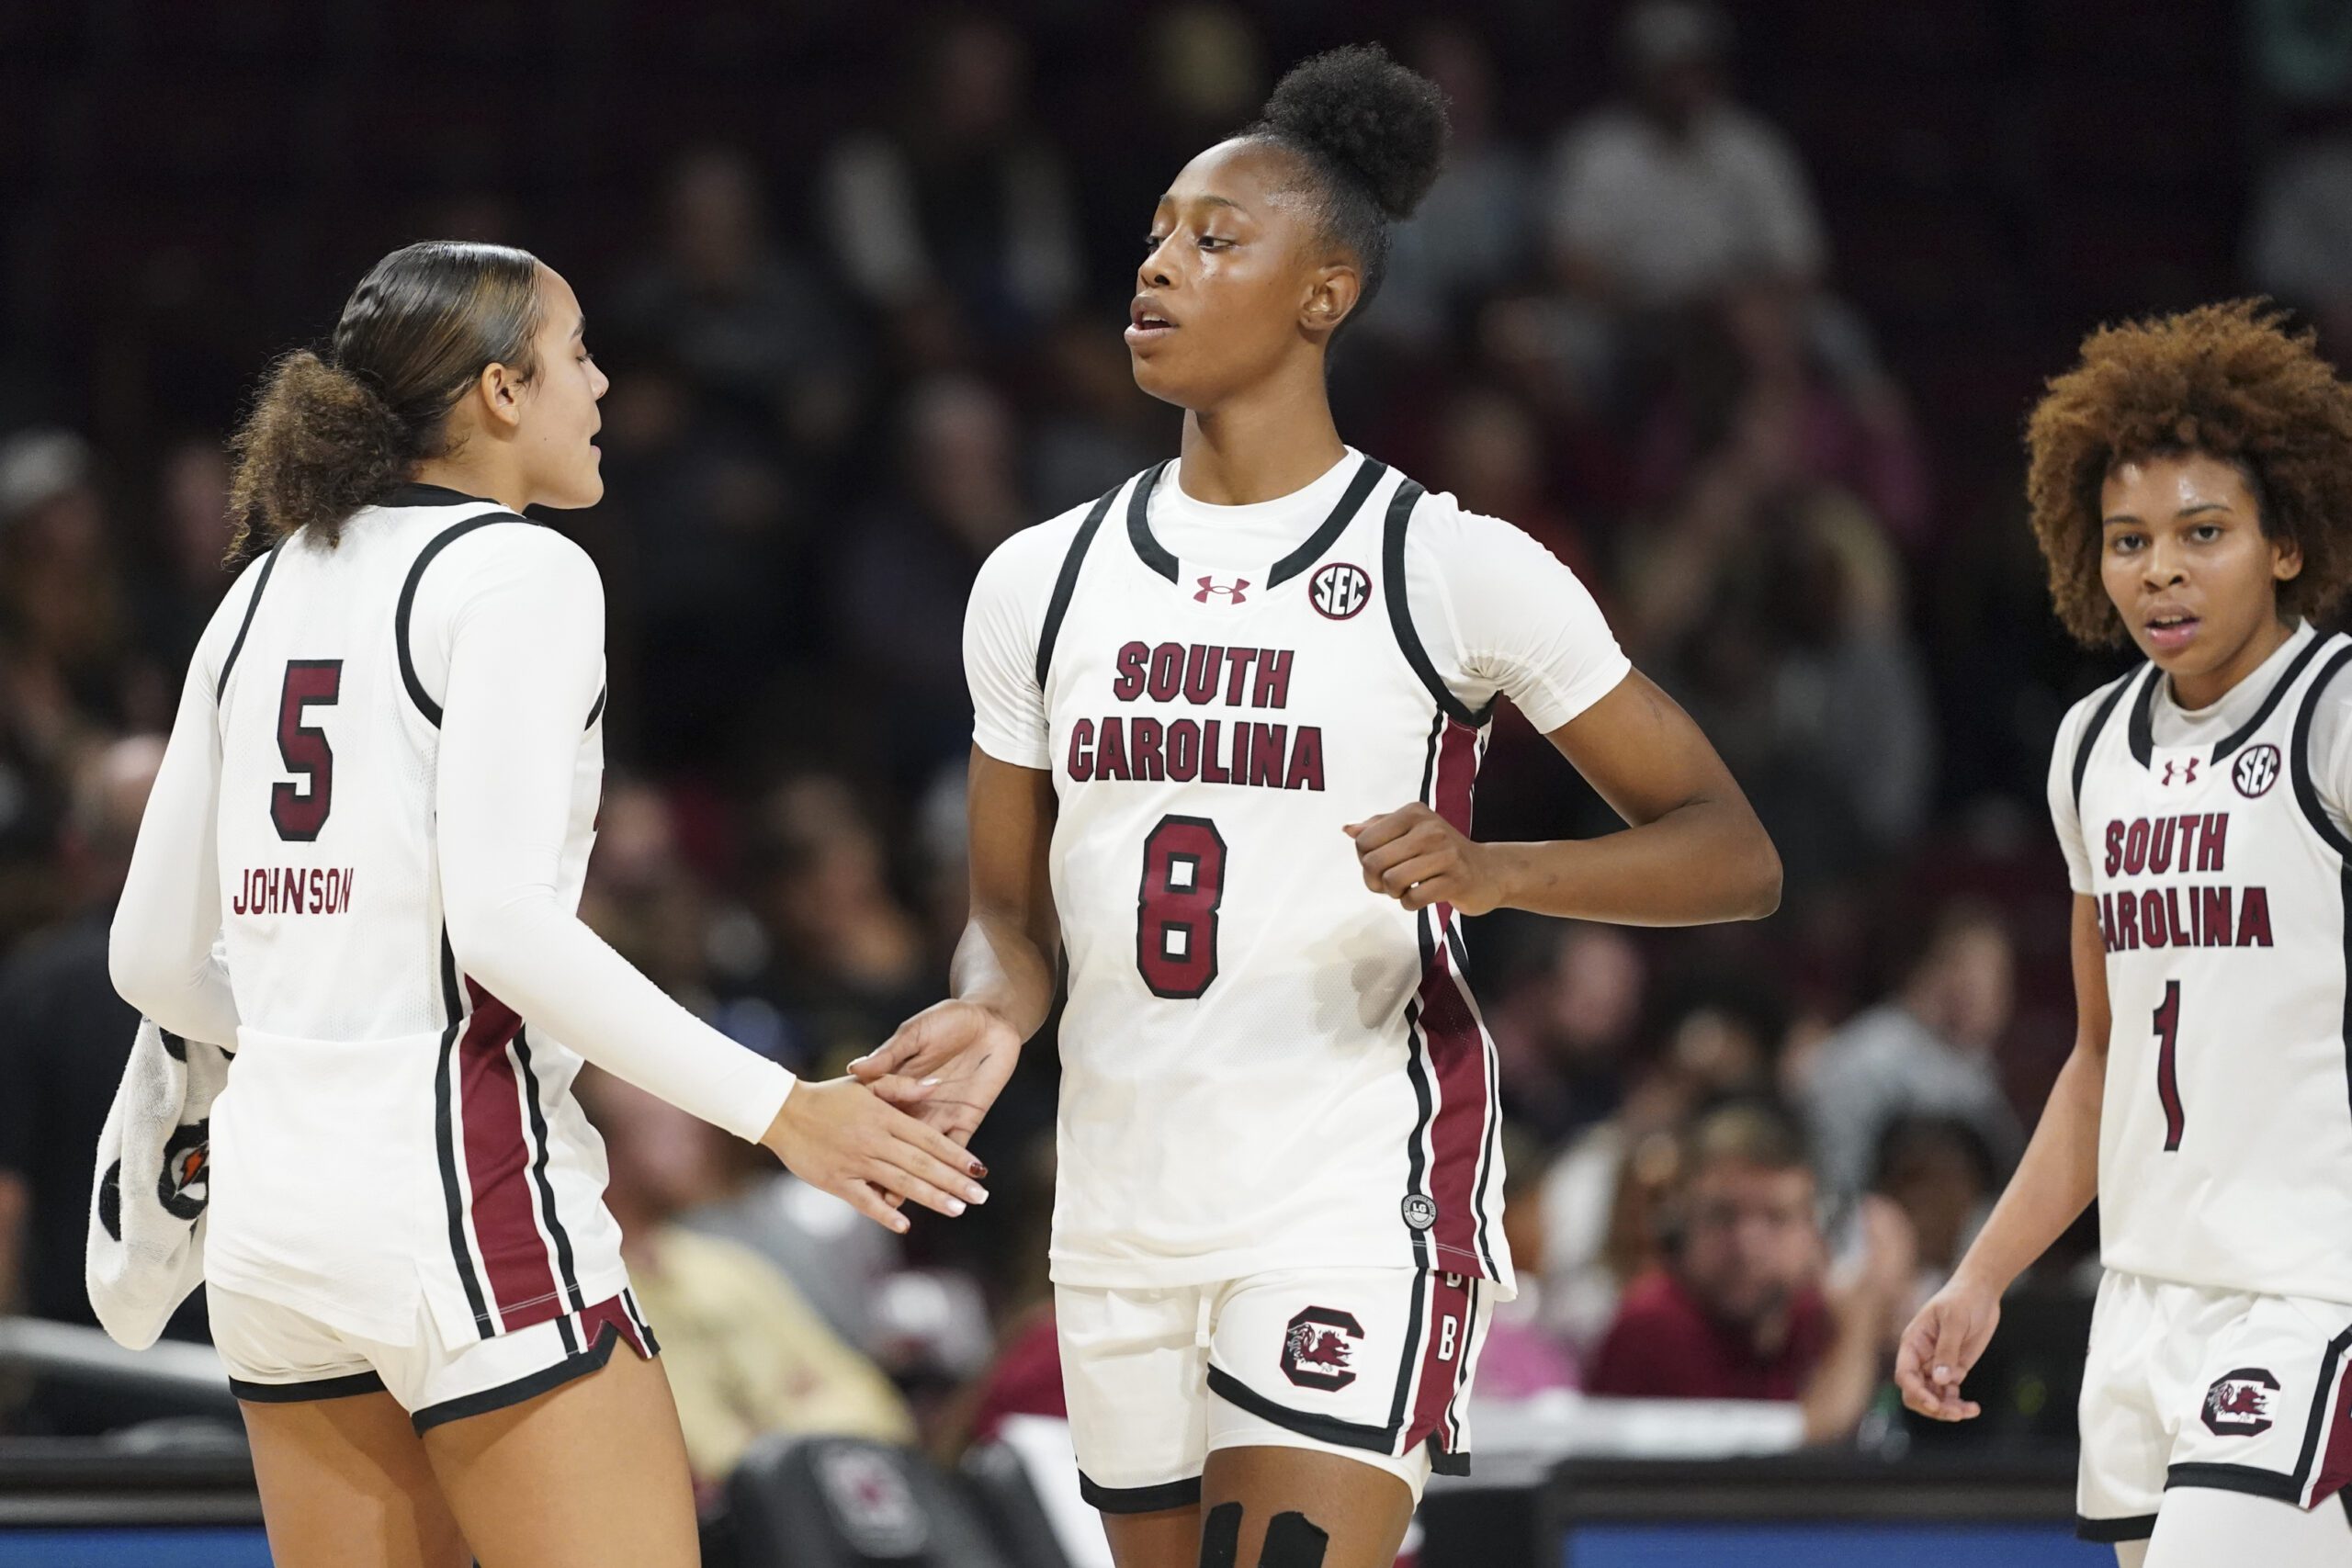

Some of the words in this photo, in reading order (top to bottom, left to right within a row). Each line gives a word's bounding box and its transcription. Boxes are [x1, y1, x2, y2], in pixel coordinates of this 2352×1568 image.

[1314, 565, 1366, 615] SEC
[1113, 641, 1295, 709] SOUTH
[270, 659, 344, 841] 5
[1068, 716, 1325, 791] CAROLINA
[2236, 746, 2278, 795] SEC
[2105, 813, 2229, 878] SOUTH
[233, 867, 354, 915] JOHNSON
[1136, 814, 1227, 999] 8
[2095, 886, 2274, 953] AROLINA
[2153, 979, 2185, 1152] 1
[1437, 1314, 1459, 1361] B
